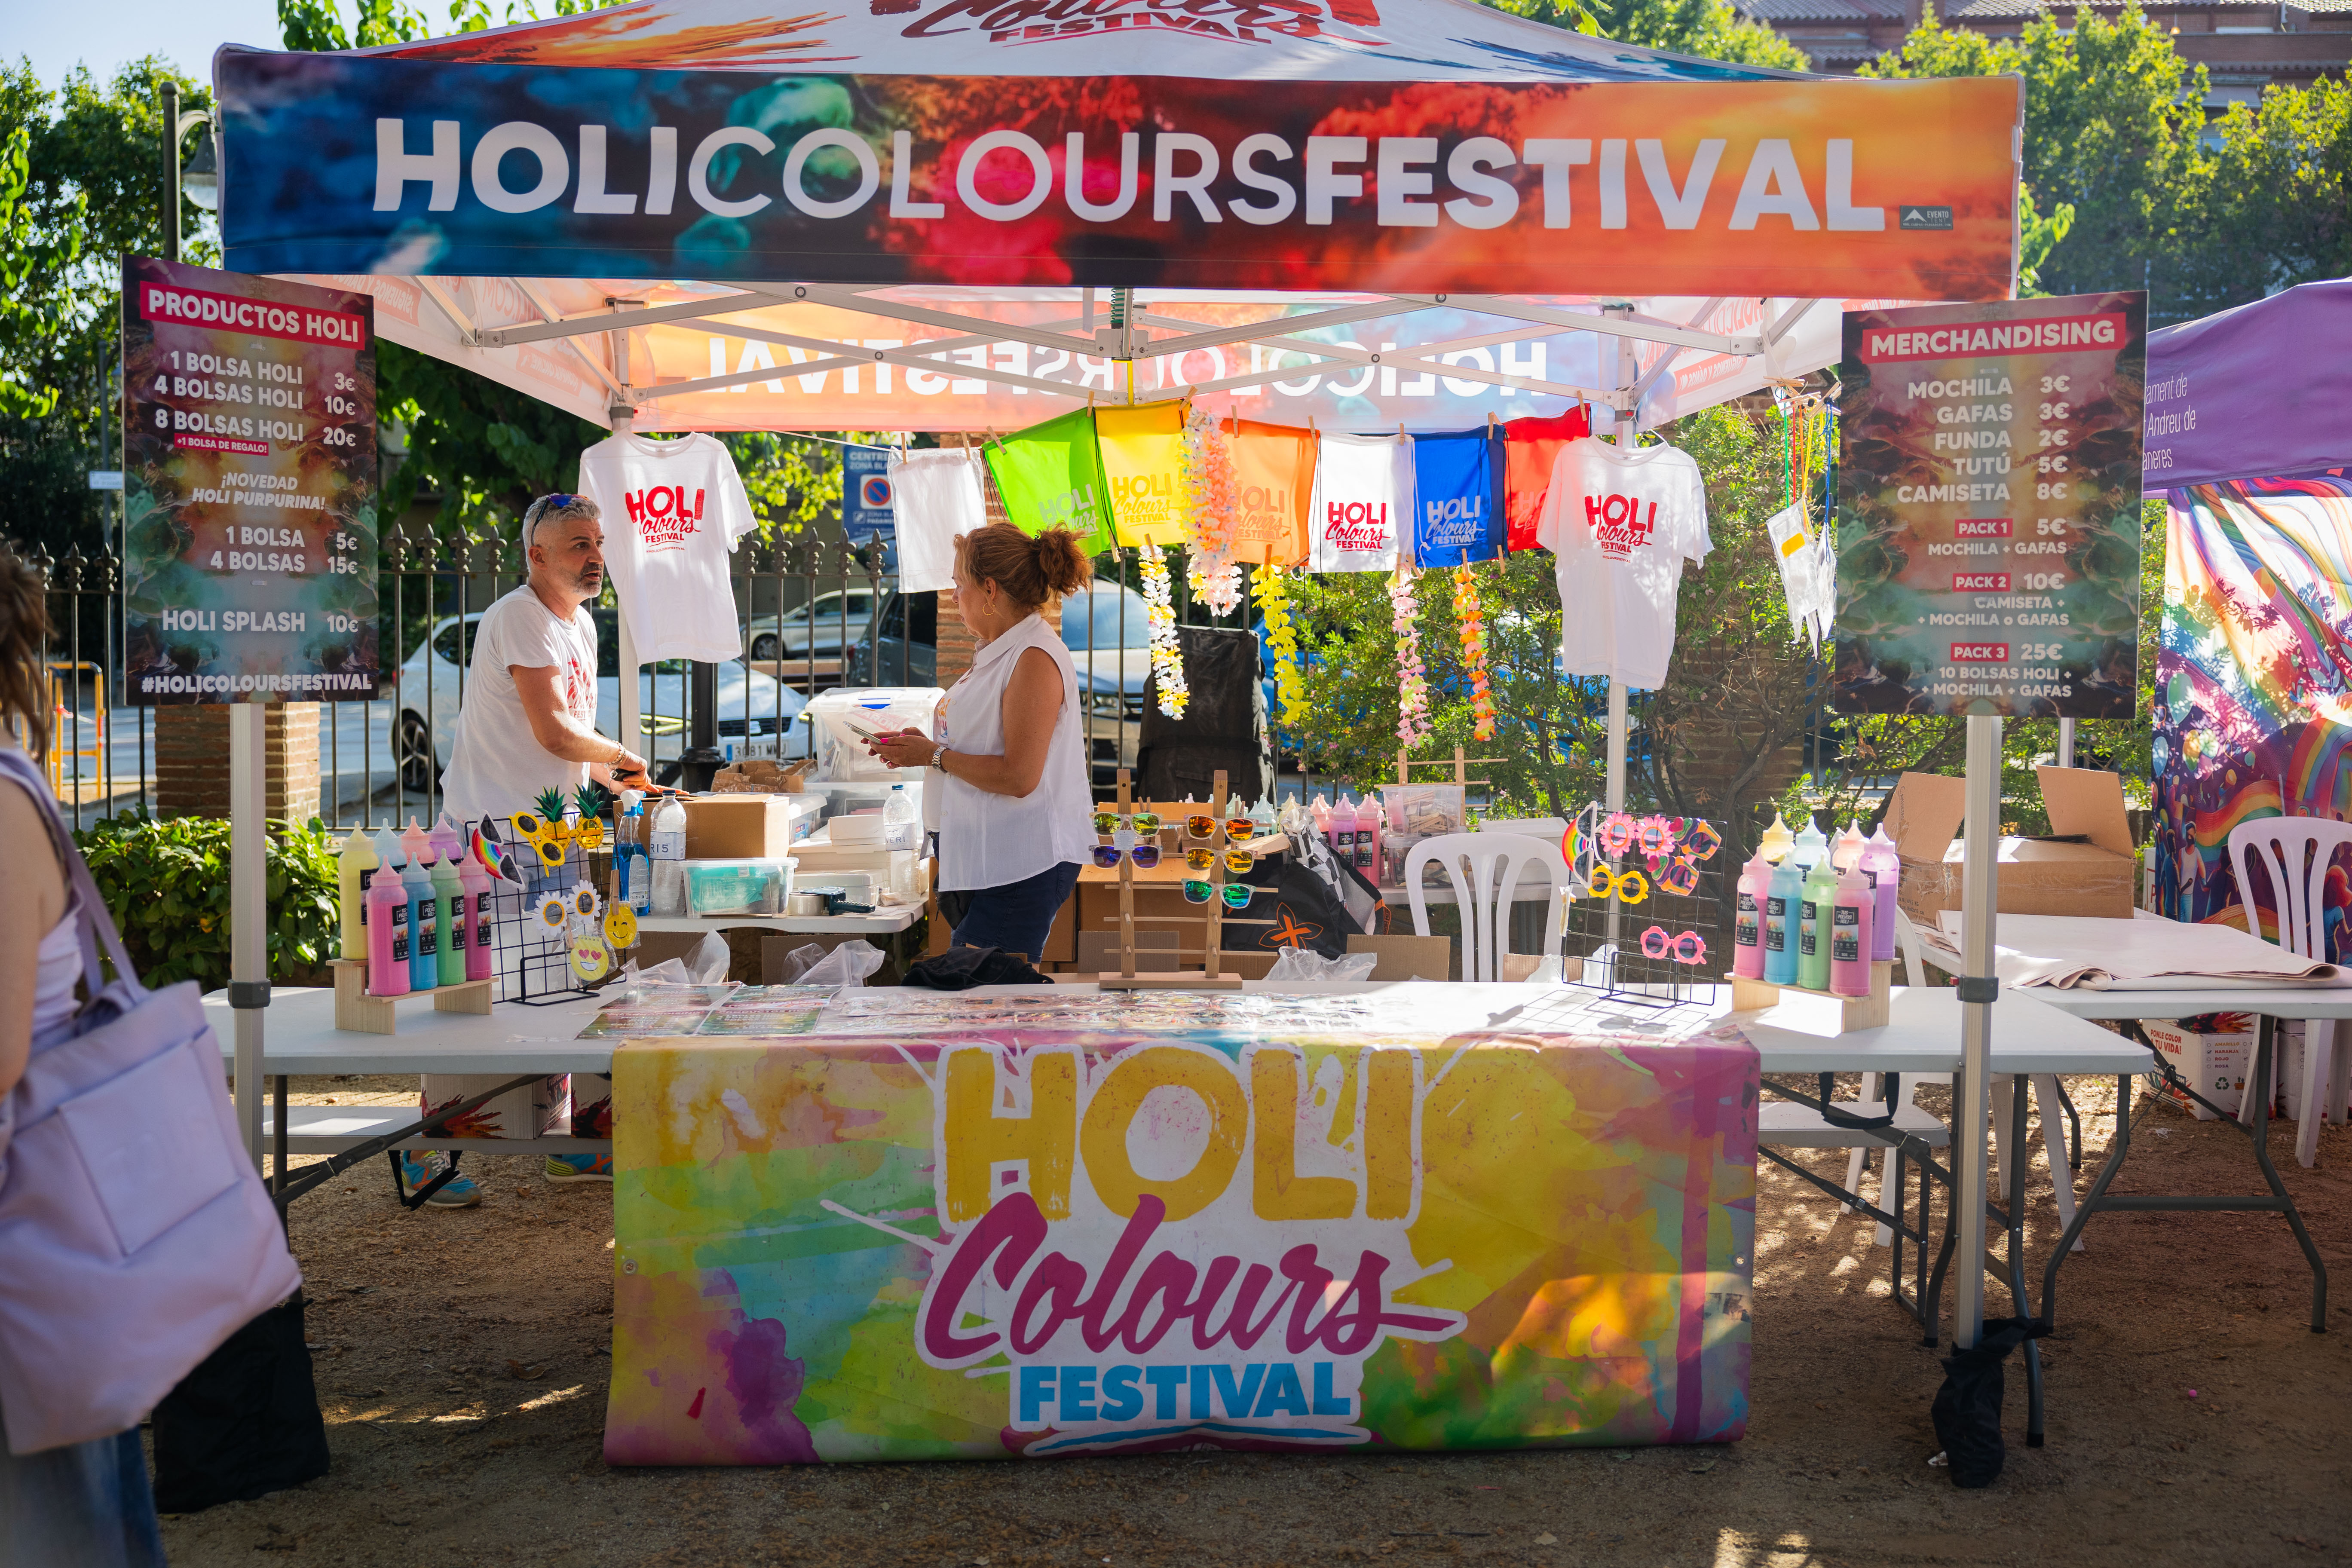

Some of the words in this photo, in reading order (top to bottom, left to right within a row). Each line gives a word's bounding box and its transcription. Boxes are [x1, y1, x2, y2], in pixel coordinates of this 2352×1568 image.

[989, 11, 1272, 45] FESTIVAL
[373, 117, 1885, 233] HOLICOLOURSFESTIVAL
[148, 288, 300, 335] PRODUCTOS
[306, 313, 359, 343] HOLI
[1871, 320, 2116, 357] MERCHANDISING
[171, 351, 180, 369] 1
[186, 352, 253, 379] BOLSA
[257, 362, 303, 385] HOLI
[334, 372, 355, 392] 3€
[154, 375, 167, 395] 4
[174, 376, 253, 404] BOLSAS
[258, 387, 303, 410] HOLI
[324, 395, 356, 416] 10€
[1908, 377, 2013, 400] MOCHILA
[2040, 375, 2070, 394] 3€
[2176, 372, 2187, 398] de
[1937, 403, 2013, 424] GAFAS
[2039, 402, 2070, 420] 3€
[2146, 410, 2181, 438] Andreu
[2184, 404, 2196, 431] de
[155, 409, 168, 429] 8
[174, 410, 253, 437] BOLSAS
[258, 419, 303, 442] HOLI
[322, 426, 356, 447] 20€
[1935, 429, 2012, 450] FUNDA
[2038, 429, 2069, 447] 2€
[177, 437, 187, 445] +1
[188, 438, 217, 449] BOLSA
[218, 441, 231, 450] DE
[231, 442, 267, 454] REGALO!
[1953, 452, 2012, 476] TUTÚ
[2038, 456, 2068, 473] 5€
[2142, 448, 2173, 471] aneres
[220, 472, 298, 491] ¡NOVEDAD
[1112, 473, 1173, 499] HOLI
[1896, 483, 2011, 503] CAMISETA
[2037, 482, 2067, 500] 8€
[192, 488, 230, 504] HOLI
[233, 492, 326, 511] PURPURINA!
[625, 485, 705, 524] HOLI
[1038, 484, 1096, 523] HOLI
[1113, 494, 1180, 515] Colours
[1426, 495, 1481, 524] HOLI
[1124, 513, 1171, 524] FESTIVAL
[1328, 501, 1386, 525] HOLI
[1585, 494, 1657, 534] HOLI
[226, 526, 235, 545] 1
[241, 527, 305, 548] BOLSA
[336, 532, 358, 551] 5€
[645, 533, 685, 543] FESTIVAL
[1237, 528, 1282, 540] ESTIVAL
[1325, 520, 1391, 542] Colours
[1426, 518, 1485, 539] Colours
[1958, 522, 1998, 535] PACK
[2001, 522, 2008, 534] 1
[2036, 518, 2066, 536] 5€
[1336, 540, 1383, 550] FESTIVAL
[1432, 534, 1477, 545] FESTIVAL
[1928, 542, 1999, 556] MOCHILA
[2014, 542, 2067, 555] GAFAS
[210, 551, 224, 569] 4
[229, 551, 306, 572] BOLSAS
[327, 556, 358, 575] 15€
[1955, 576, 1996, 589] PACK
[1997, 576, 2006, 588] 2
[2023, 573, 2065, 590] 10€
[1975, 597, 2053, 609] CAMISETA
[2057, 599, 2065, 607] +
[162, 609, 216, 631] HOLI
[222, 610, 306, 632] SPLASH
[326, 615, 359, 633] 10€
[1917, 616, 1925, 625] +
[1929, 613, 2000, 626] MOCHILA
[2004, 616, 2013, 626] o
[2017, 613, 2070, 626] GAFAS
[1954, 647, 1994, 659] PACK
[1996, 647, 2005, 659] 3
[2020, 643, 2063, 661] 25€
[141, 673, 372, 694] #HOLICOLOURSFESTIVAL
[1939, 667, 1956, 679] 10
[1959, 667, 2019, 680] BOLSAS
[2022, 668, 2060, 680] HOLI
[2064, 671, 2072, 680] +
[1922, 686, 1929, 694] +
[1933, 683, 2003, 696] MOCHILA
[2008, 687, 2016, 695] +
[2019, 684, 2072, 698] GAFAS
[2150, 1029, 2164, 1040] PONLE
[2165, 1033, 2182, 1044] COLOR
[2155, 1039, 2162, 1050] TU
[2164, 1042, 2181, 1055] VIDA!
[944, 1046, 1415, 1224] HOLI
[924, 1191, 1458, 1360] Colours
[1019, 1361, 1351, 1422] FESTIVAL
